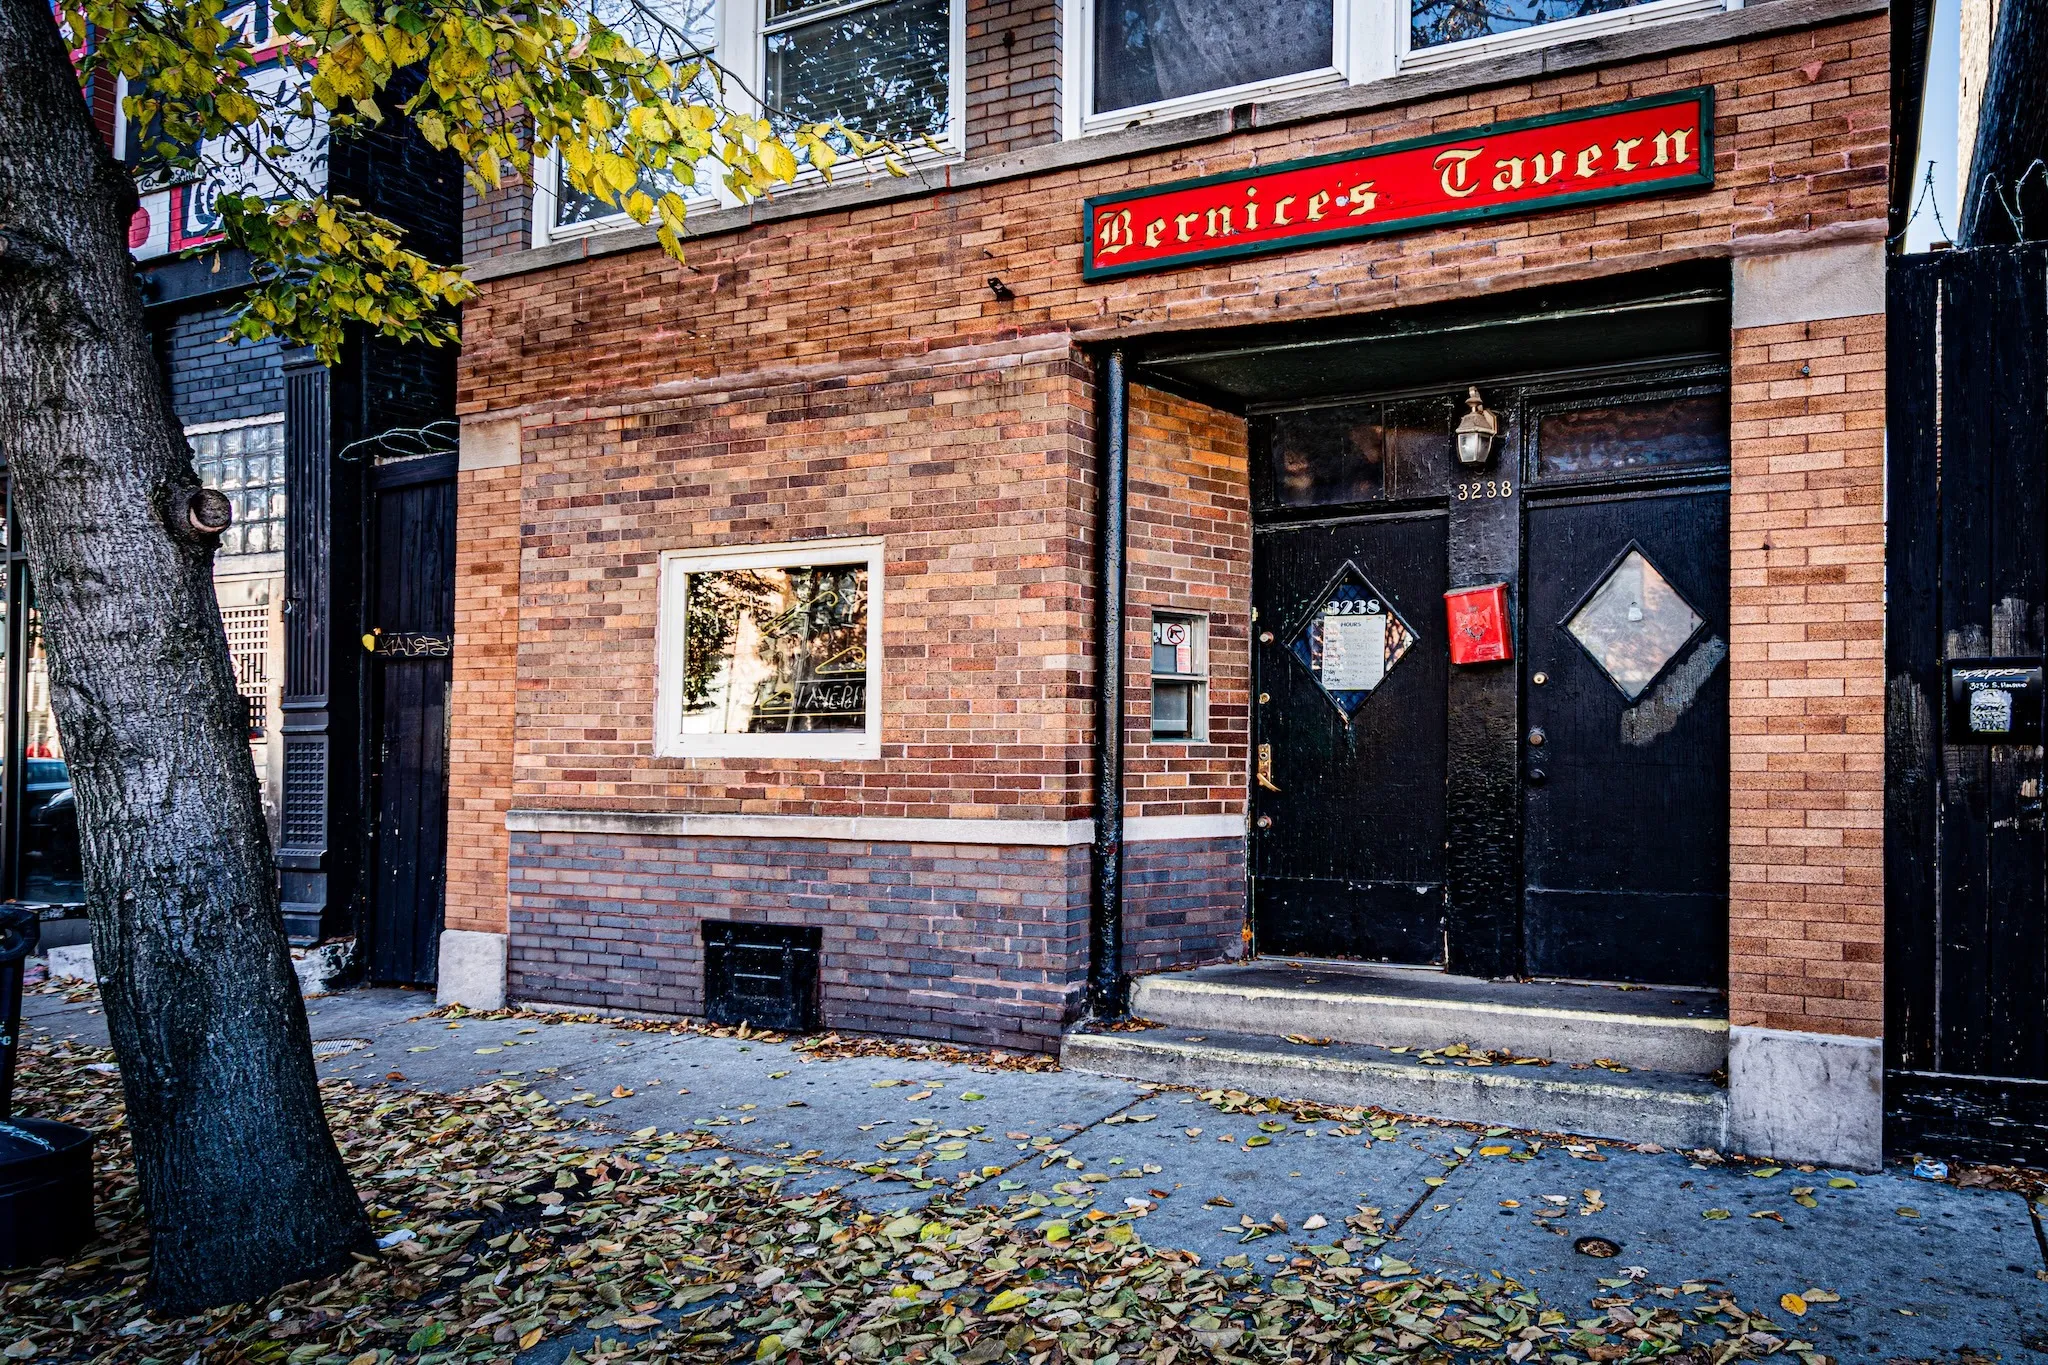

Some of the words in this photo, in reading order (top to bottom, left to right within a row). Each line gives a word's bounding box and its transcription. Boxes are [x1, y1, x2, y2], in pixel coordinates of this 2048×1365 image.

[1097, 180, 1378, 257] Bernice's
[1433, 126, 1694, 198] Tavern
[1458, 480, 1512, 500] 3238
[1328, 599, 1380, 615] 3238
